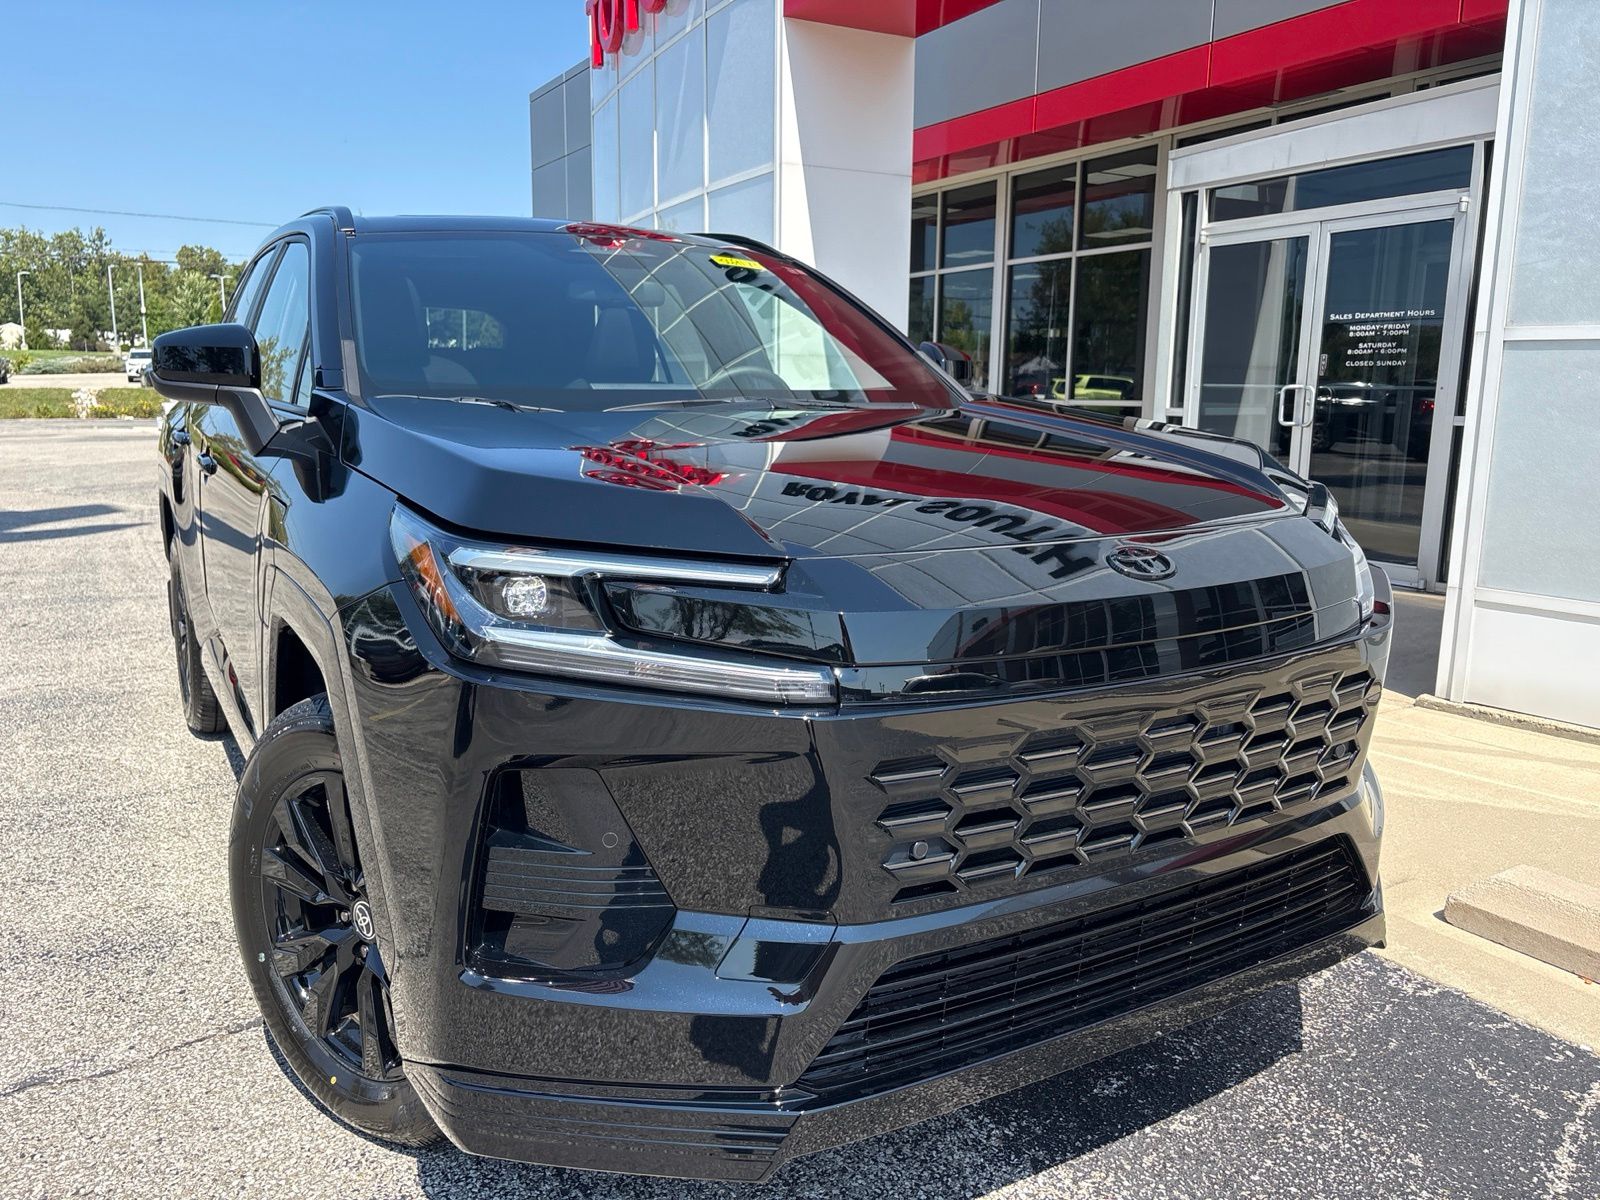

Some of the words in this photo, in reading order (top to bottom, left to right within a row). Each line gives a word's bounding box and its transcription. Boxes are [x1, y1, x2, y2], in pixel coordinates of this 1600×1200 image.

[1355, 311, 1405, 319] DEPARTMENT
[1407, 309, 1436, 317] HOURS
[1349, 323, 1411, 331] MONDAY-FRIDAY
